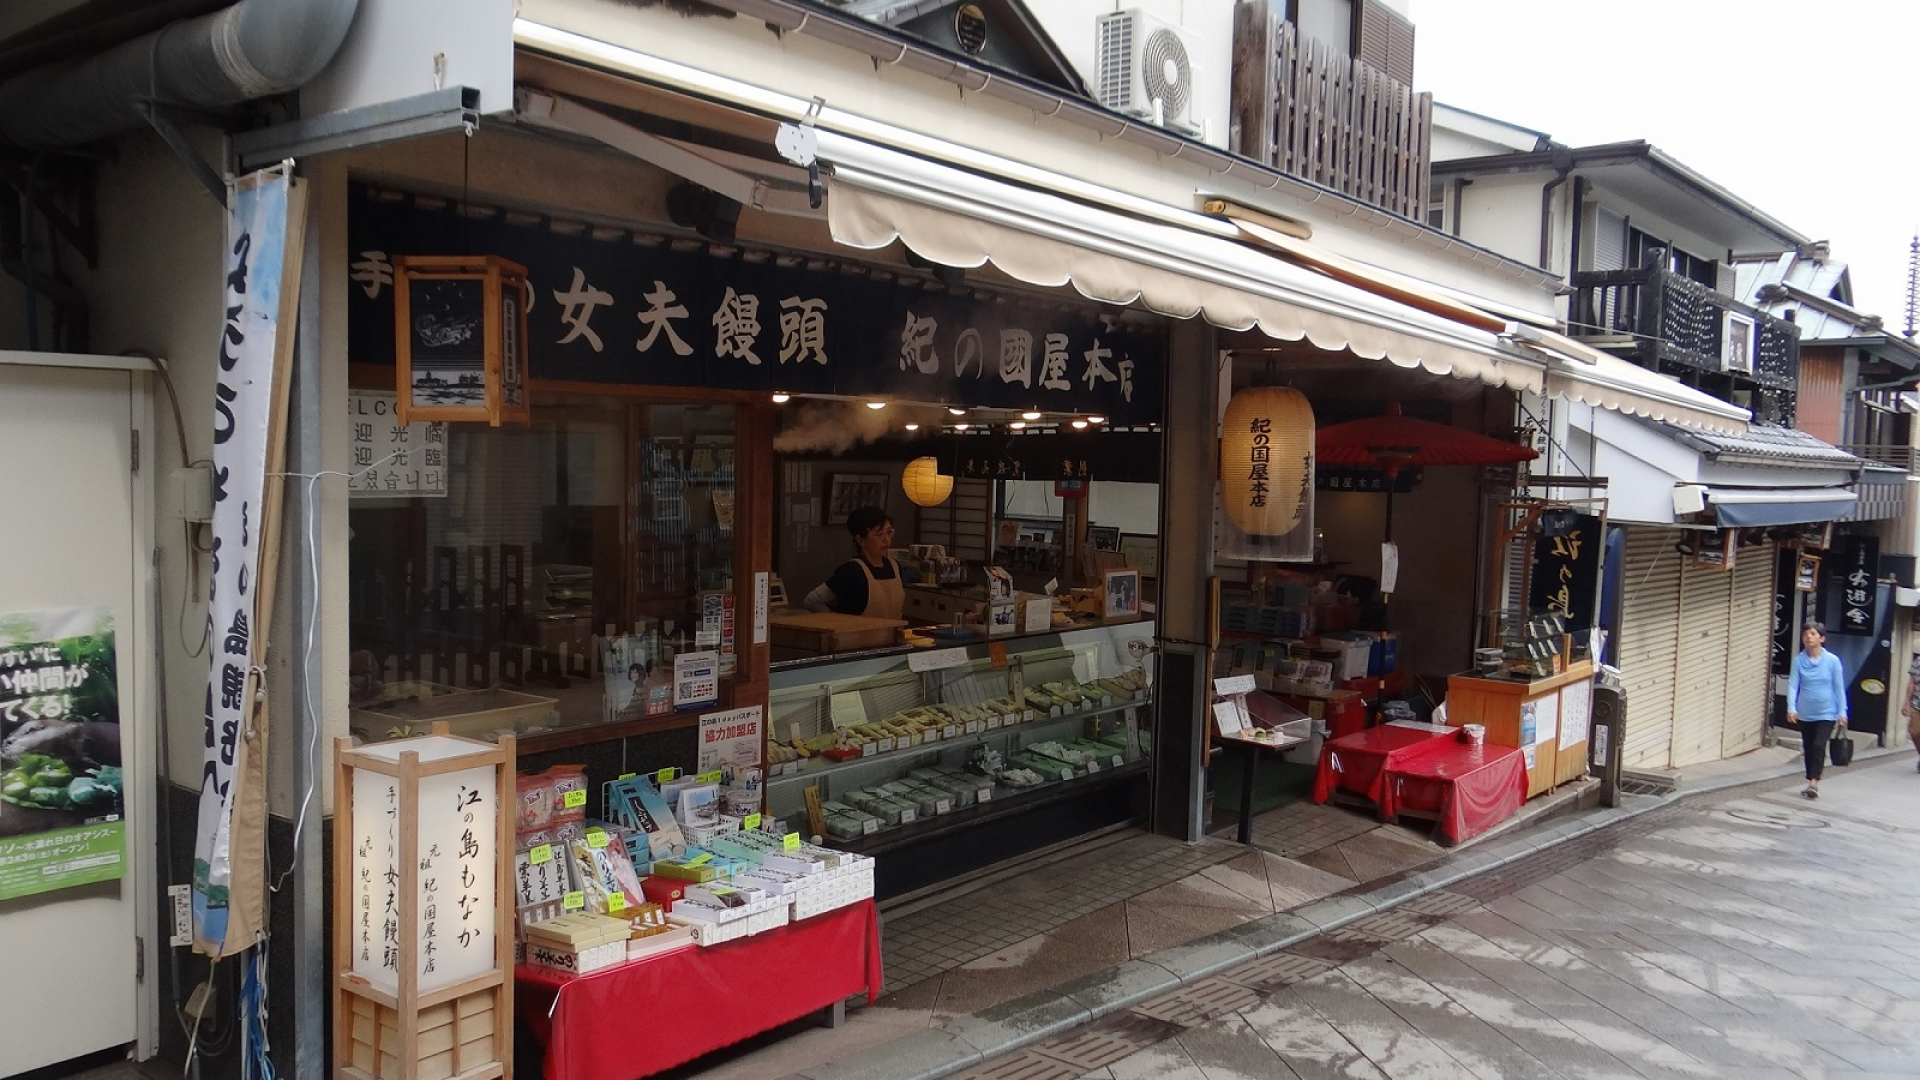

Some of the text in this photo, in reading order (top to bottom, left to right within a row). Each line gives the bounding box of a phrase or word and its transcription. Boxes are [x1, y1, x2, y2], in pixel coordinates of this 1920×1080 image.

[1248, 418, 1271, 507] 紀の国屋本店
[705, 721, 757, 744] 協力加盟店
[456, 785, 482, 949] 江の島もなか
[422, 877, 438, 976] 紀の国屋本店
